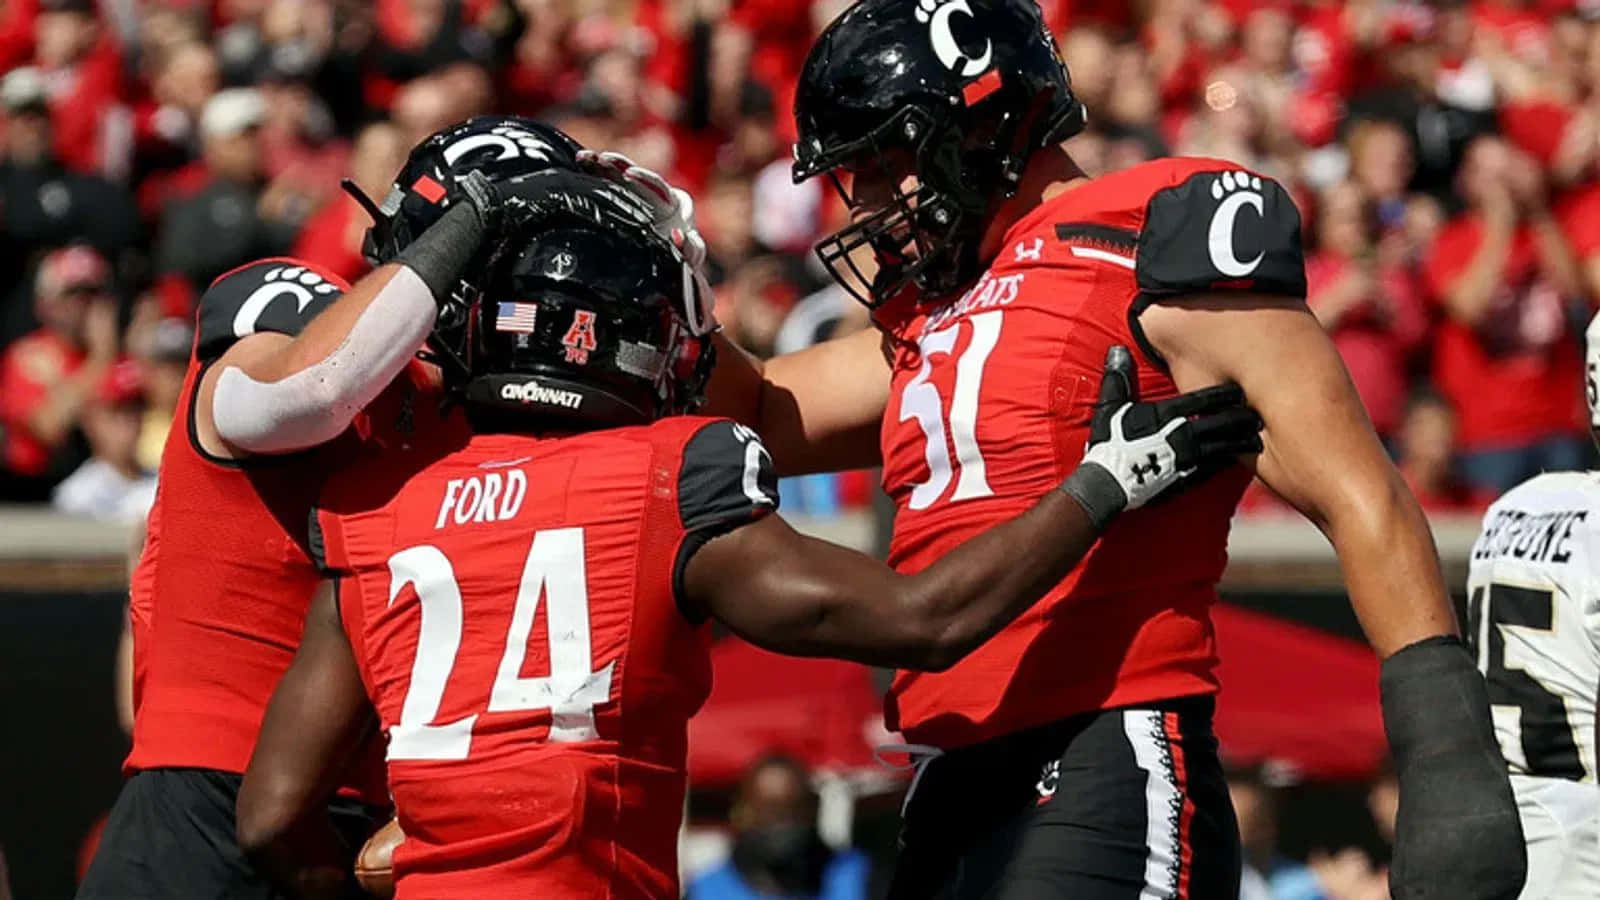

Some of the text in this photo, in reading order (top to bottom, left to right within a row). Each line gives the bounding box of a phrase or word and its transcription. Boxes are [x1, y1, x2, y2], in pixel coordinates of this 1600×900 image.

[930, 0, 993, 77] C
[1208, 191, 1266, 277] C
[925, 270, 1024, 333] CATS
[502, 381, 583, 409] CINCINNATI
[899, 309, 1004, 510] 51
[435, 469, 528, 529] FORD
[385, 527, 617, 762] 24
